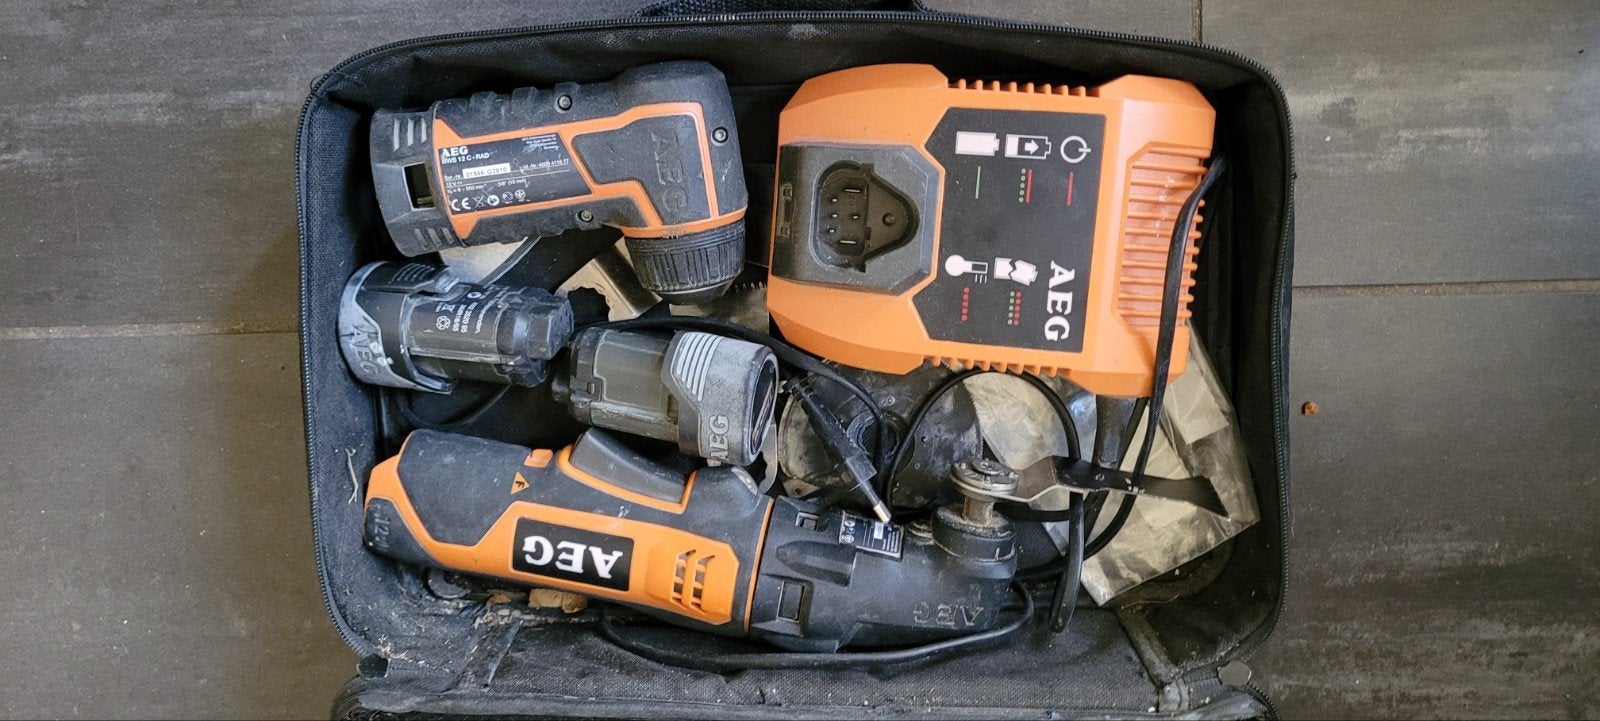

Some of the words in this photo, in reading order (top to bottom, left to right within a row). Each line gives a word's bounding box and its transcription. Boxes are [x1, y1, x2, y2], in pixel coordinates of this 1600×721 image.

[441, 146, 468, 159] AEG
[651, 132, 688, 212] AEG
[1044, 260, 1075, 341] AEG
[353, 323, 379, 374] AEG
[709, 414, 729, 461] AEG
[522, 535, 624, 579] AEG
[913, 601, 984, 626] AEG
